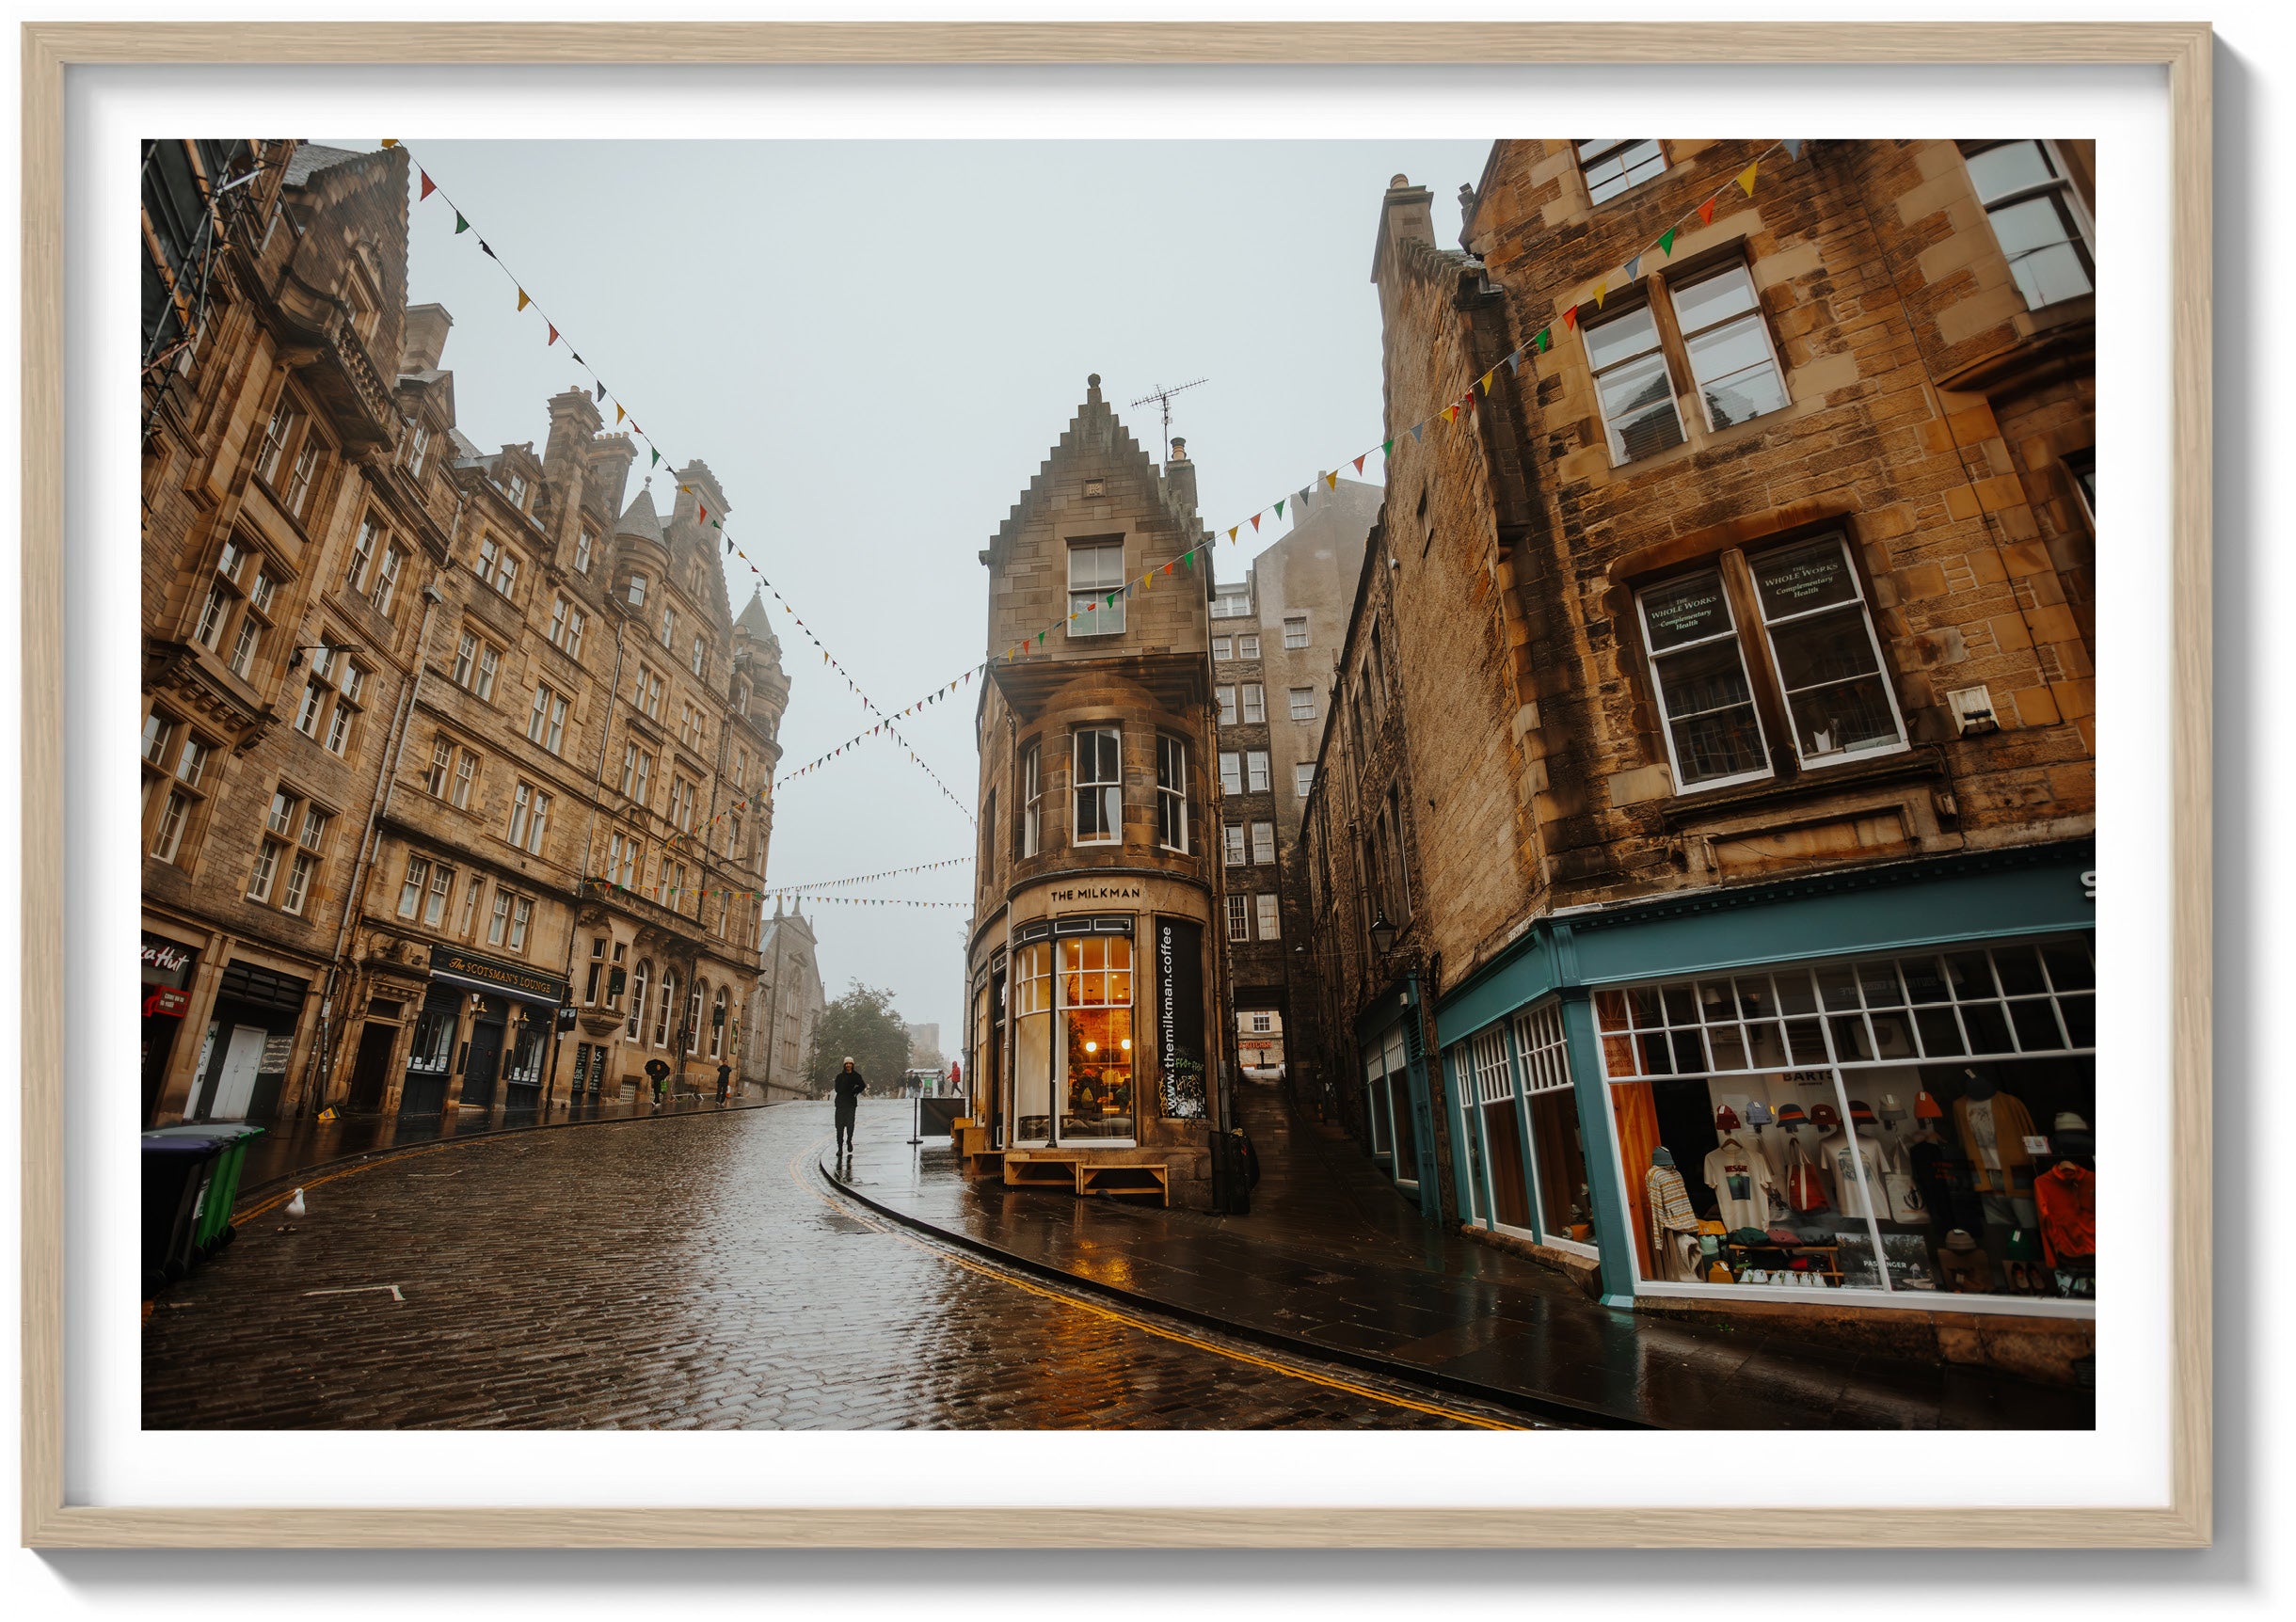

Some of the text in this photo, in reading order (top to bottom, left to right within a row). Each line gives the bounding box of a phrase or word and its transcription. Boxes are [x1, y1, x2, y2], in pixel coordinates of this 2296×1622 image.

[1764, 563, 1839, 586] WHOLE WORKS
[1776, 576, 1833, 595] Complementary
[1794, 587, 1819, 598] Health
[1651, 596, 1717, 619] WHOLE WORKS
[1660, 610, 1712, 628] Complementary
[1676, 619, 1698, 630] Health
[1051, 887, 1140, 901] THE MILKMAN
[154, 946, 190, 972] Hut
[448, 957, 551, 994] The SCOTSMAN'S LOUNGE
[1782, 1070, 1834, 1082] BARTS
[1863, 1260, 1906, 1268] PASNGER
